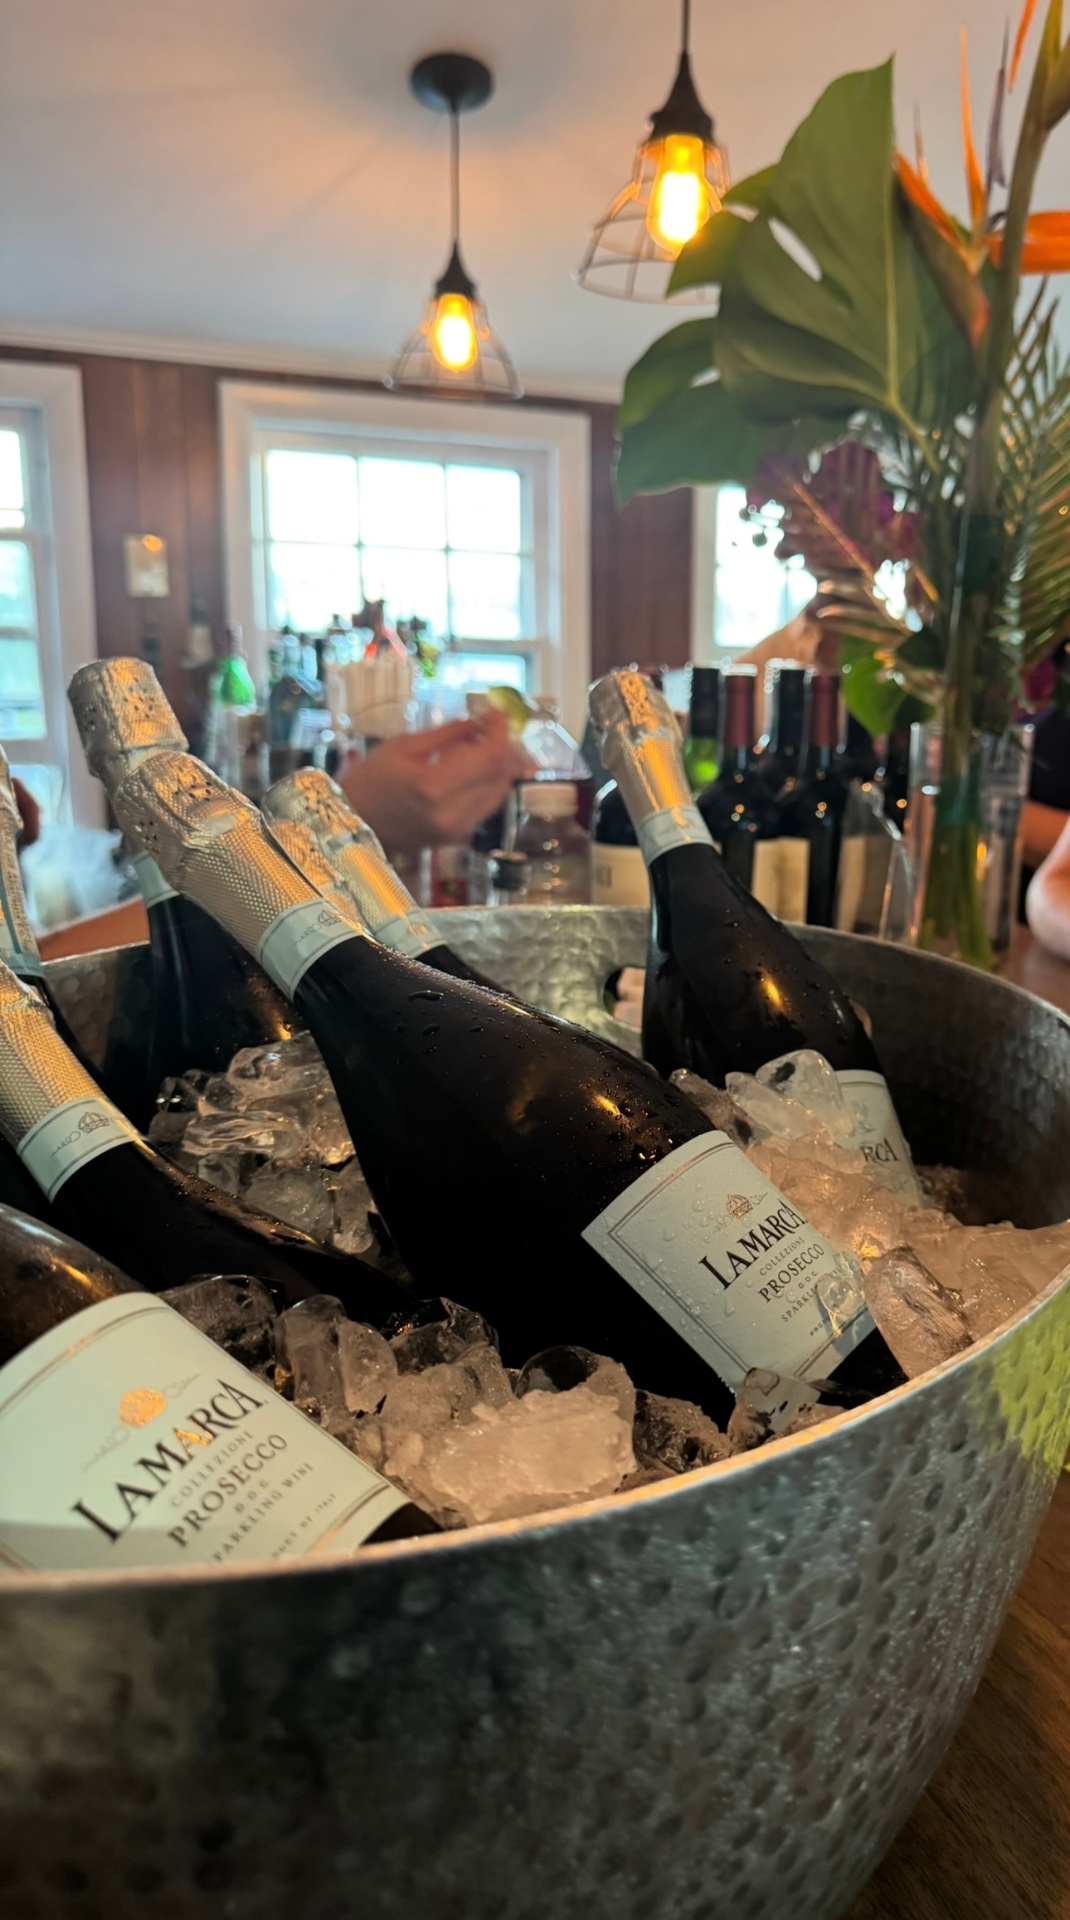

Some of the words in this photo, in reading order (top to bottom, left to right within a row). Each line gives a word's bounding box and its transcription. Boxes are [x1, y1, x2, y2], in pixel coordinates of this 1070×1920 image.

[758, 1243, 825, 1303] PROSECCO
[760, 1236, 805, 1276] COLLEZIONI
[781, 1284, 818, 1322] SPARKLI
[167, 1434, 288, 1548] PROSECCO
[171, 1430, 254, 1508] COLLEZIONI
[213, 1489, 283, 1562] PARKLING
